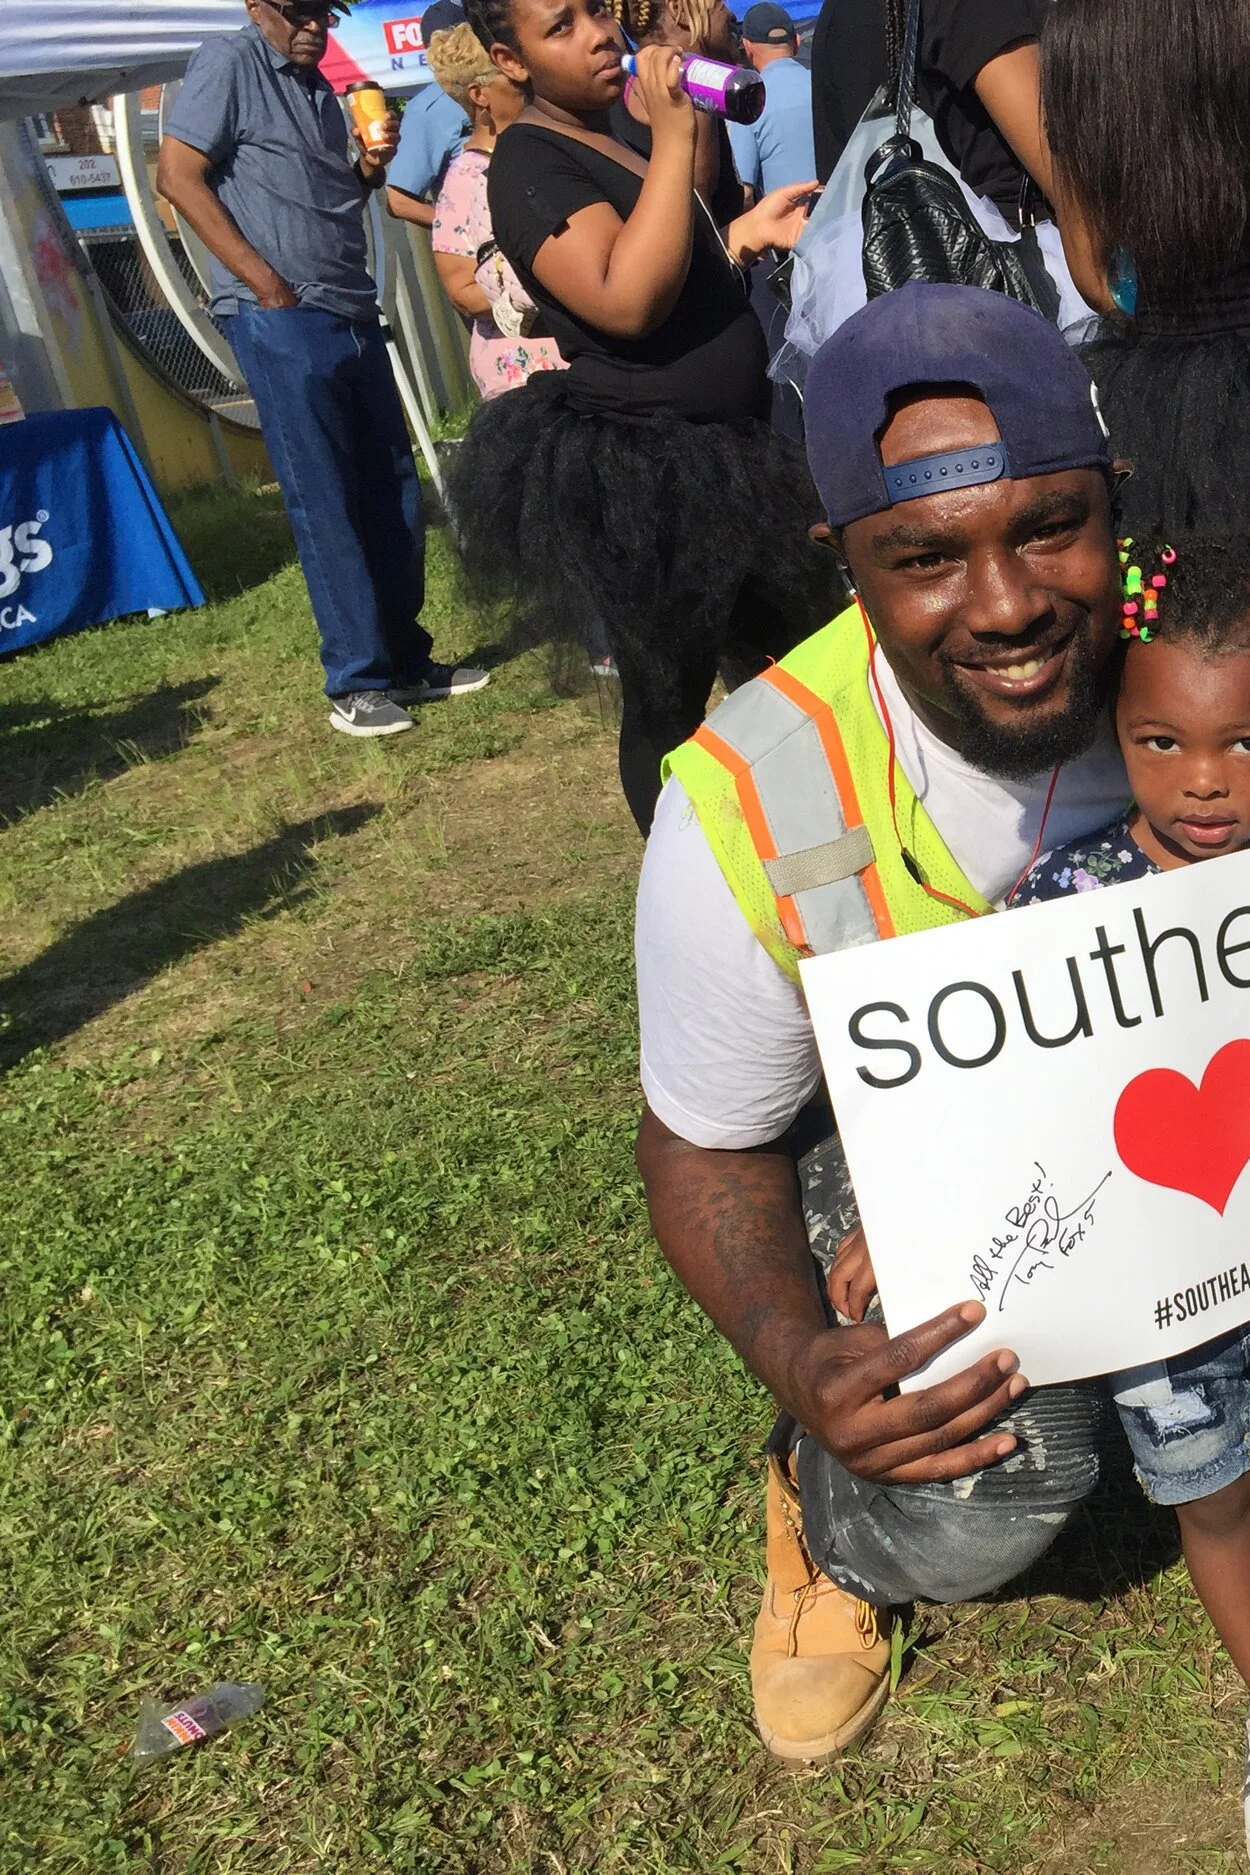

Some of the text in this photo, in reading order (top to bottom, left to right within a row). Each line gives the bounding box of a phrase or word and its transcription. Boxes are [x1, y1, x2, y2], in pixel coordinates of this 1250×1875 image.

[391, 21, 423, 50] FO
[391, 53, 428, 71] NE
[79, 159, 97, 170] 202
[0, 604, 37, 632] CA
[989, 1233, 1019, 1259] the
